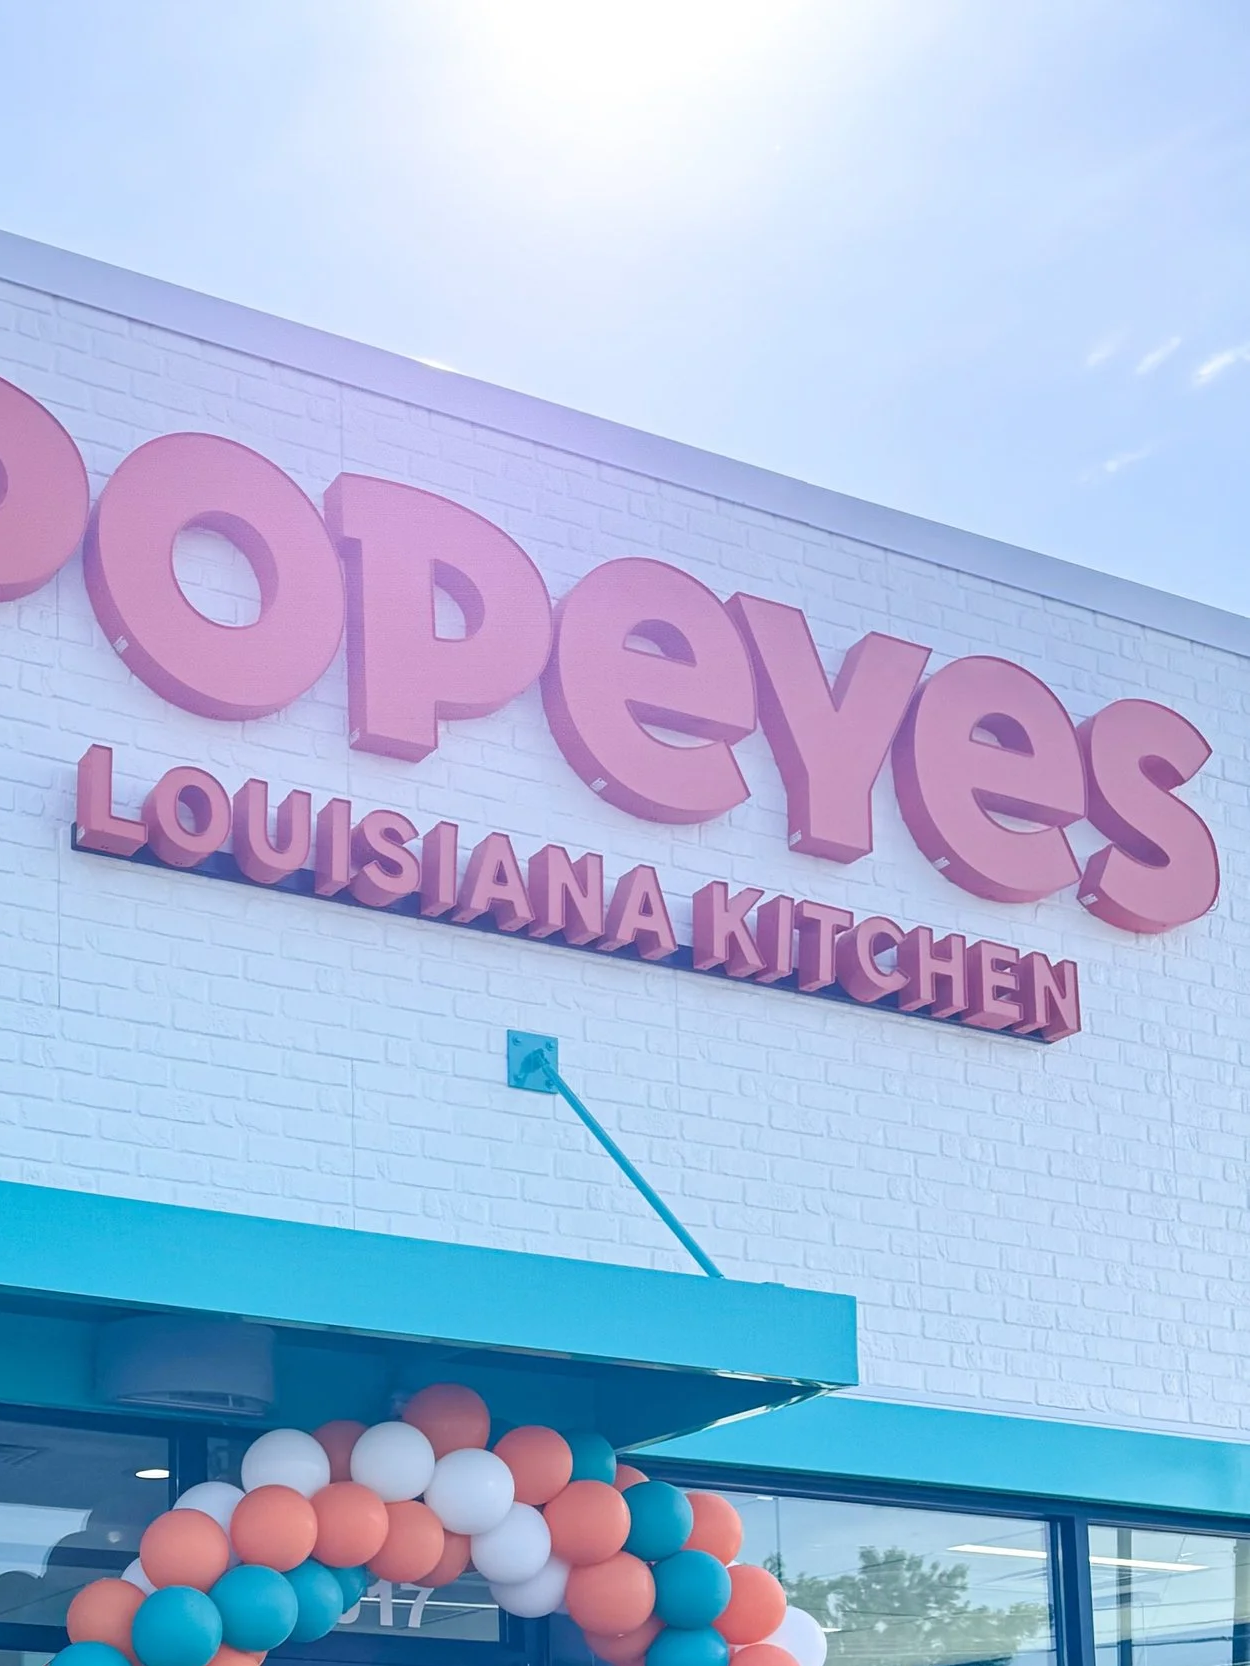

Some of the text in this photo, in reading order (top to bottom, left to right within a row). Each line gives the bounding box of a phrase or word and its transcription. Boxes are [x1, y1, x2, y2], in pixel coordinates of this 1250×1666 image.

[76, 743, 1082, 1044] LOUISIANA KITCHEN
[339, 1578, 435, 1628] 17
